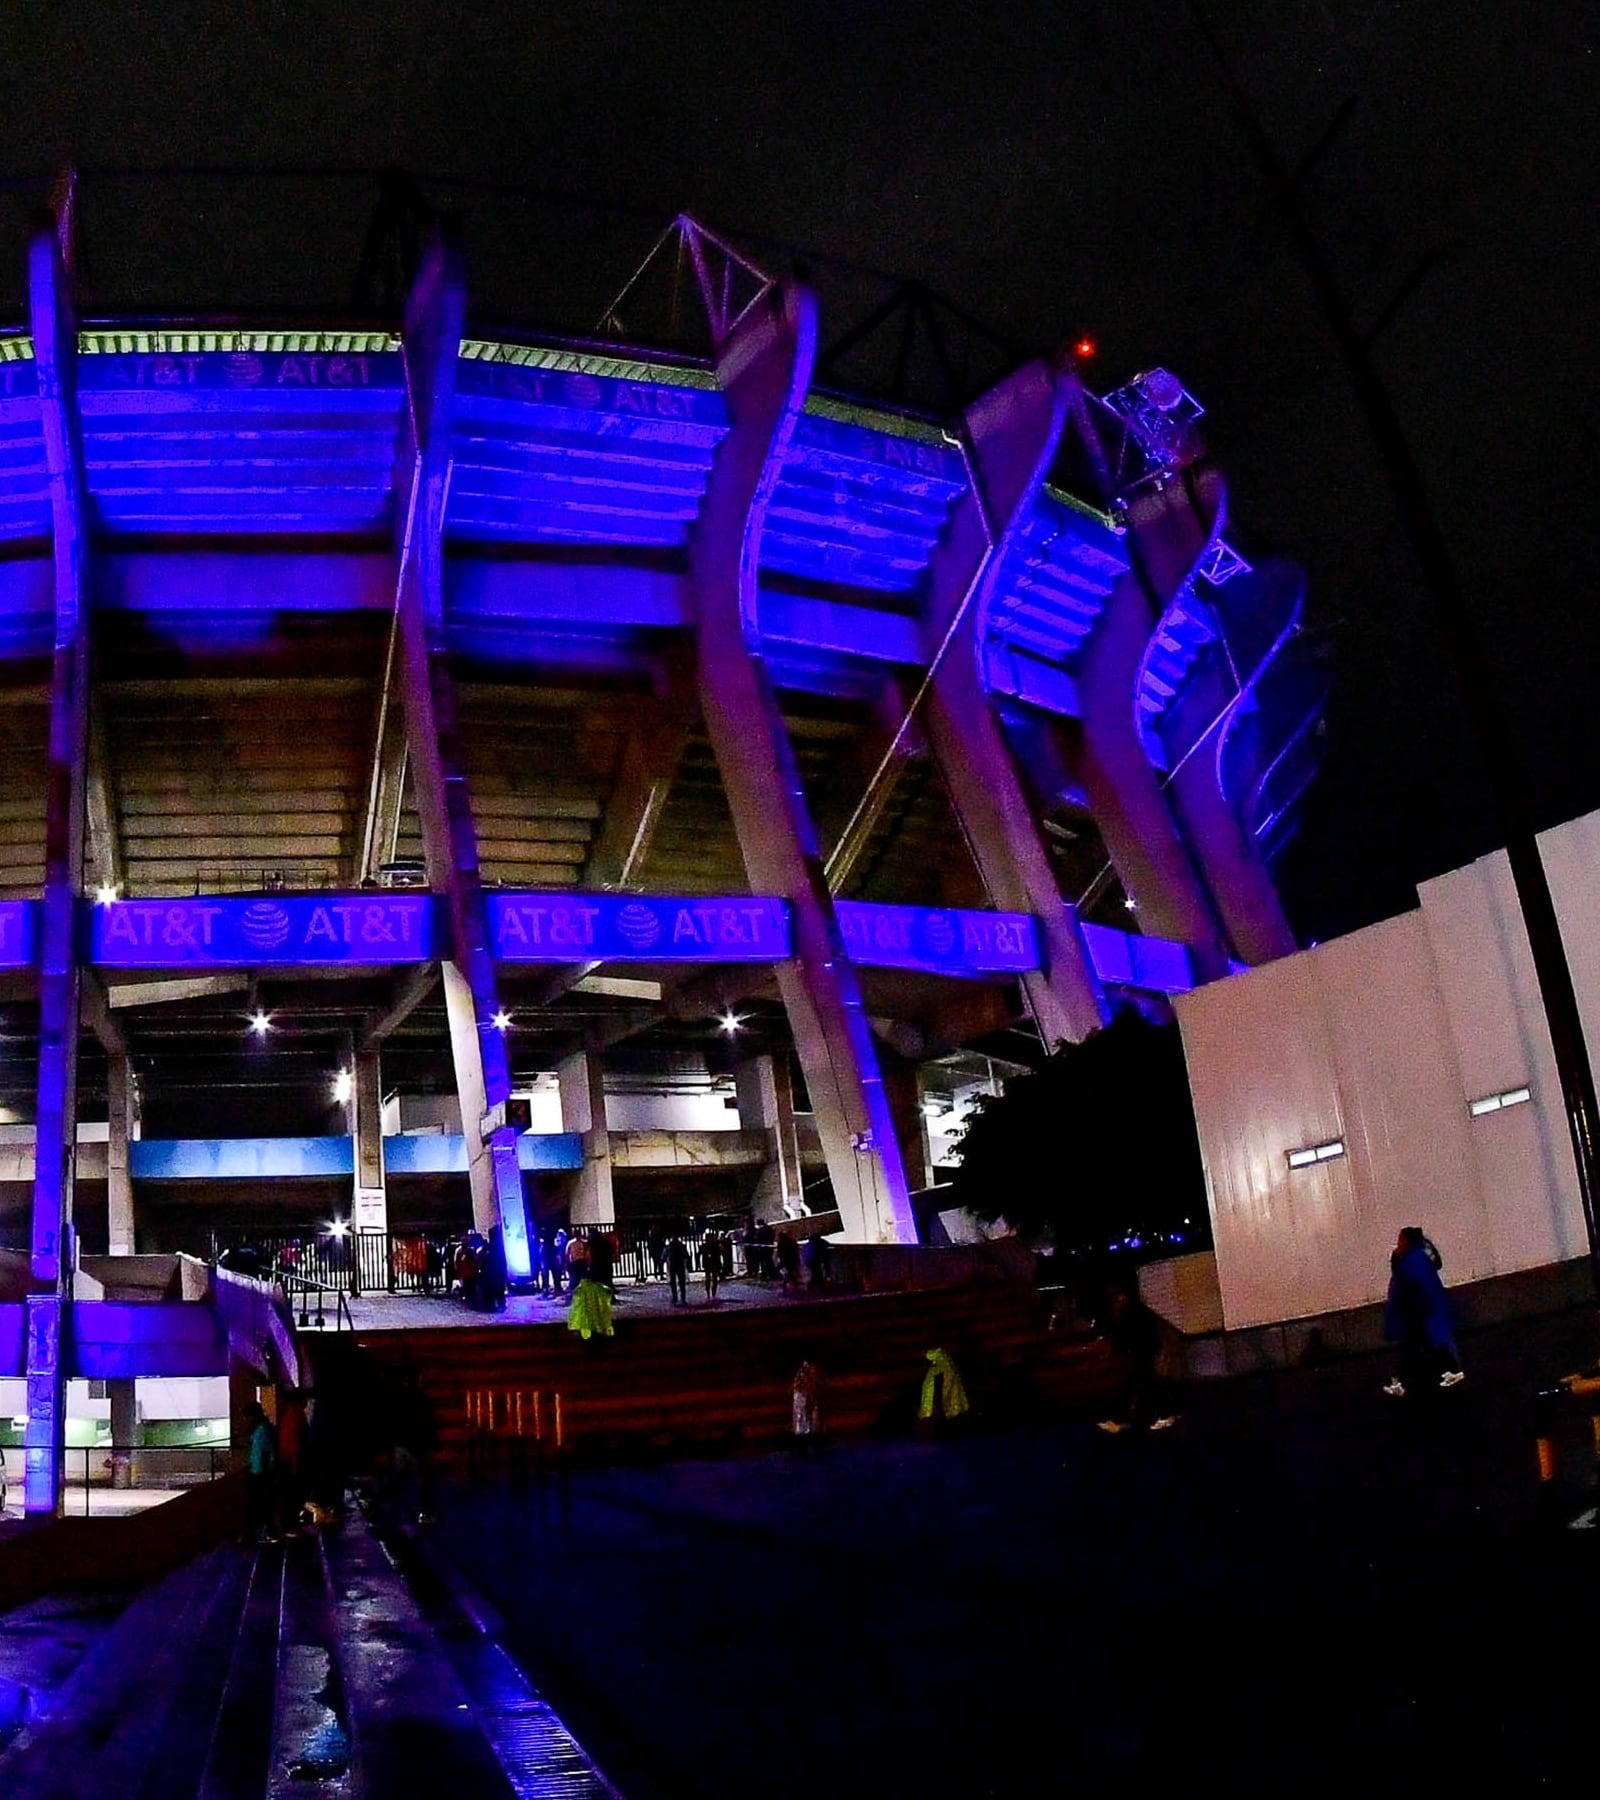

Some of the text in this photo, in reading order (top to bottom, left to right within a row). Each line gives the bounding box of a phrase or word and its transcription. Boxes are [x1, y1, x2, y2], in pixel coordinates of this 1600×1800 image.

[105, 356, 371, 386] AT&T AT&T
[105, 905, 418, 949] AT&T AT&T
[498, 907, 764, 945] AT&T AT&T
[963, 920, 1027, 955] AT&T
